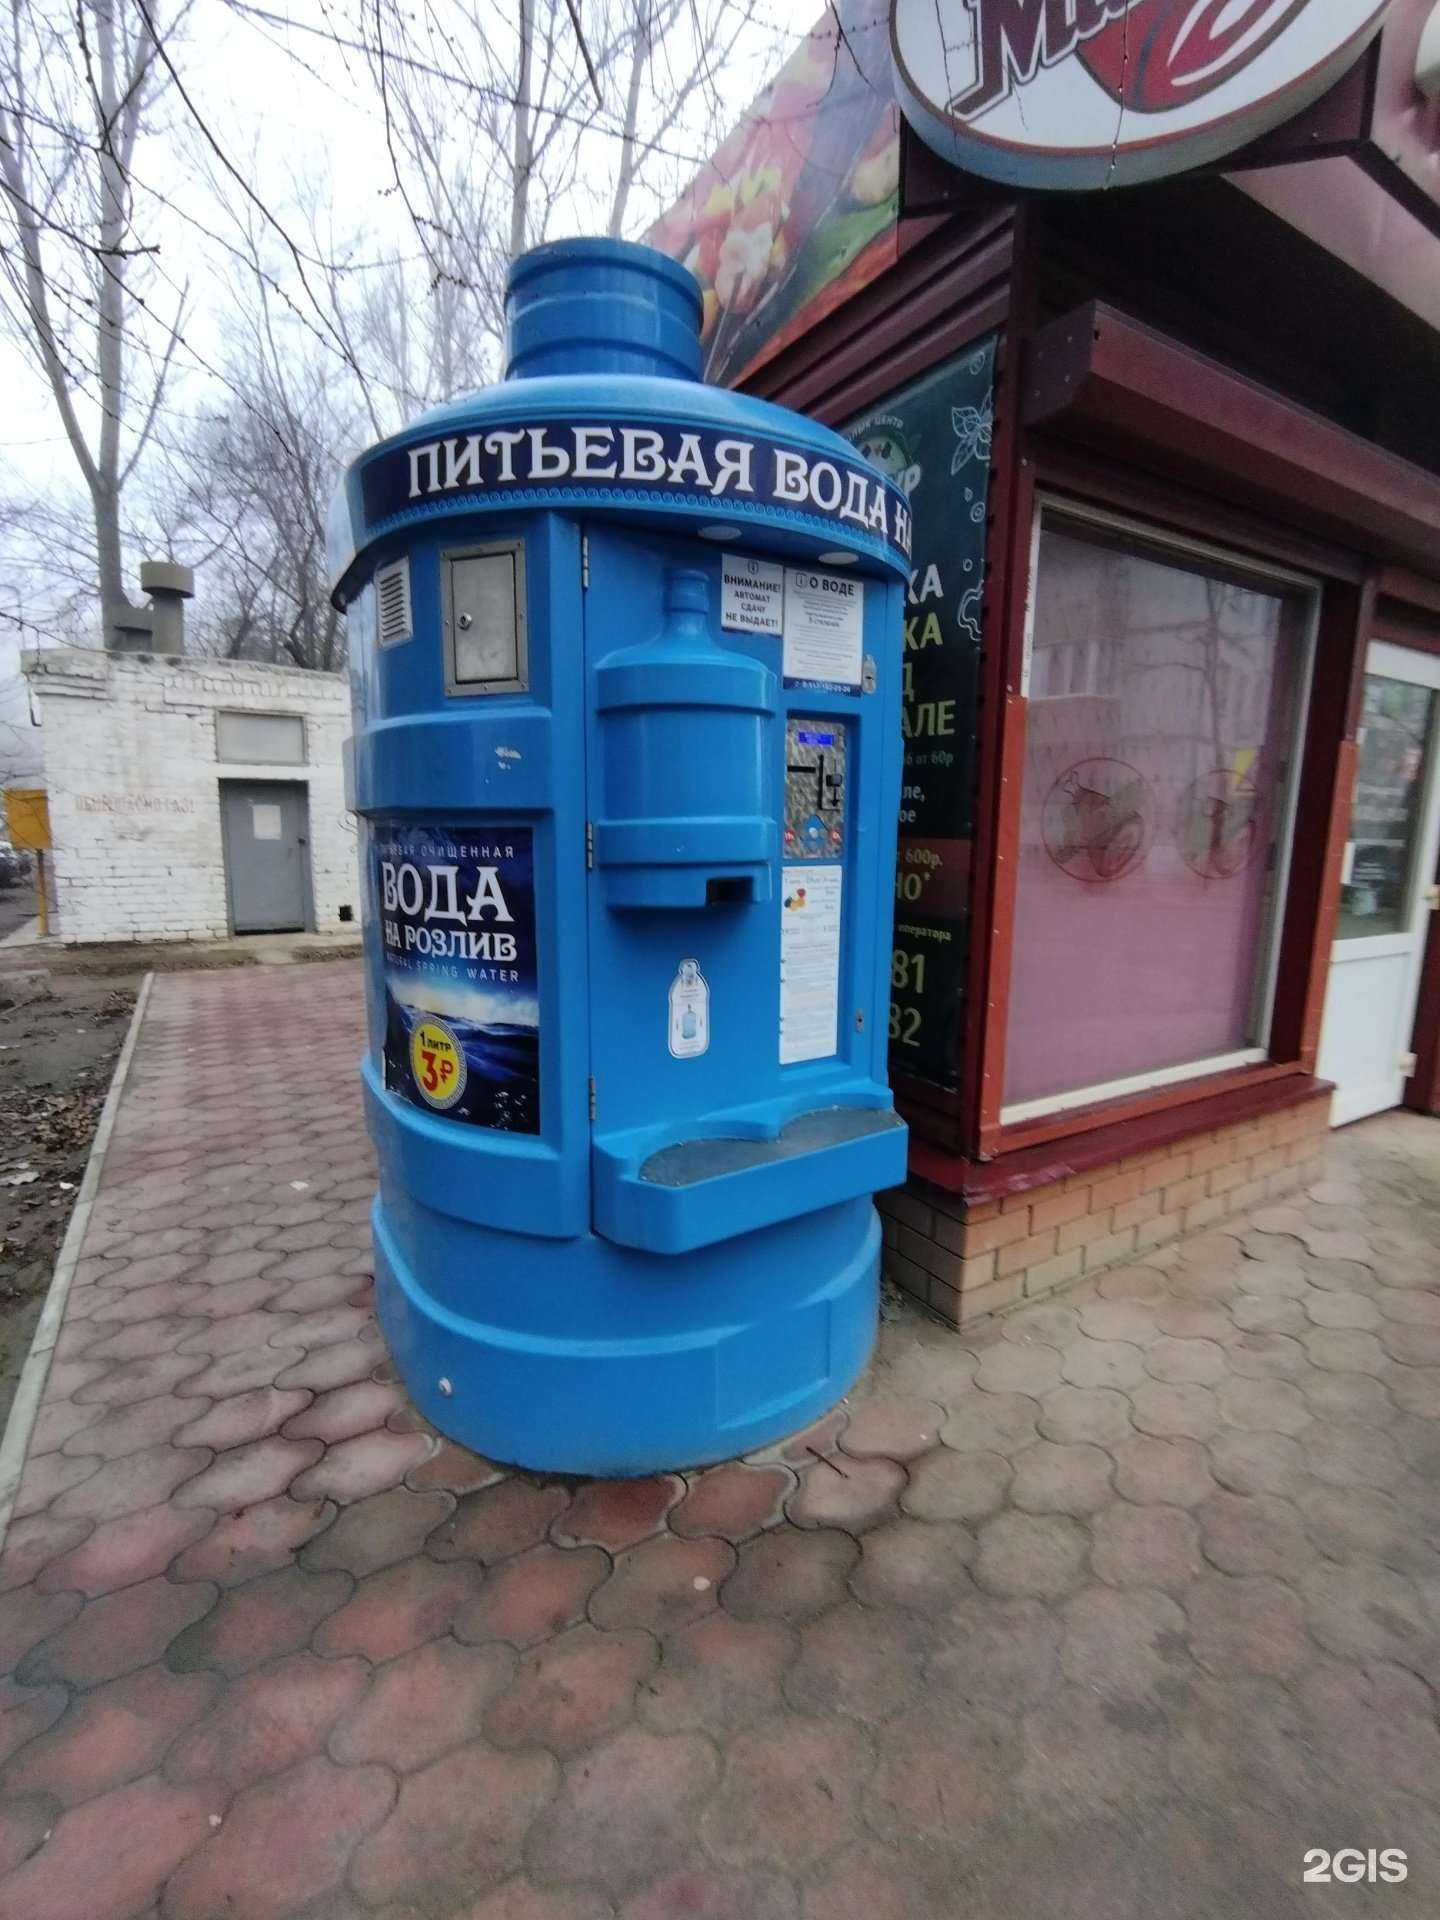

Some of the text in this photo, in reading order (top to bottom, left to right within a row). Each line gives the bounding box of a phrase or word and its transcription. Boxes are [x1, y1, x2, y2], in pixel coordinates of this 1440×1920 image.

[408, 426, 754, 498] ПИТЬЕВАЯ
[773, 448, 888, 535] ВОДА
[724, 574, 781, 593] ВНИМАНИЕ!
[809, 577, 818, 589] О
[822, 579, 855, 597] ВОДЕ
[734, 591, 770, 603] АВТОМАТ
[725, 612, 738, 623] НЕ
[421, 845, 514, 859] ОЧИЩЕННАЯ
[382, 861, 515, 927] ВОДА
[384, 920, 517, 961] НА РОЗЛИВ
[467, 968, 520, 982] WATER
